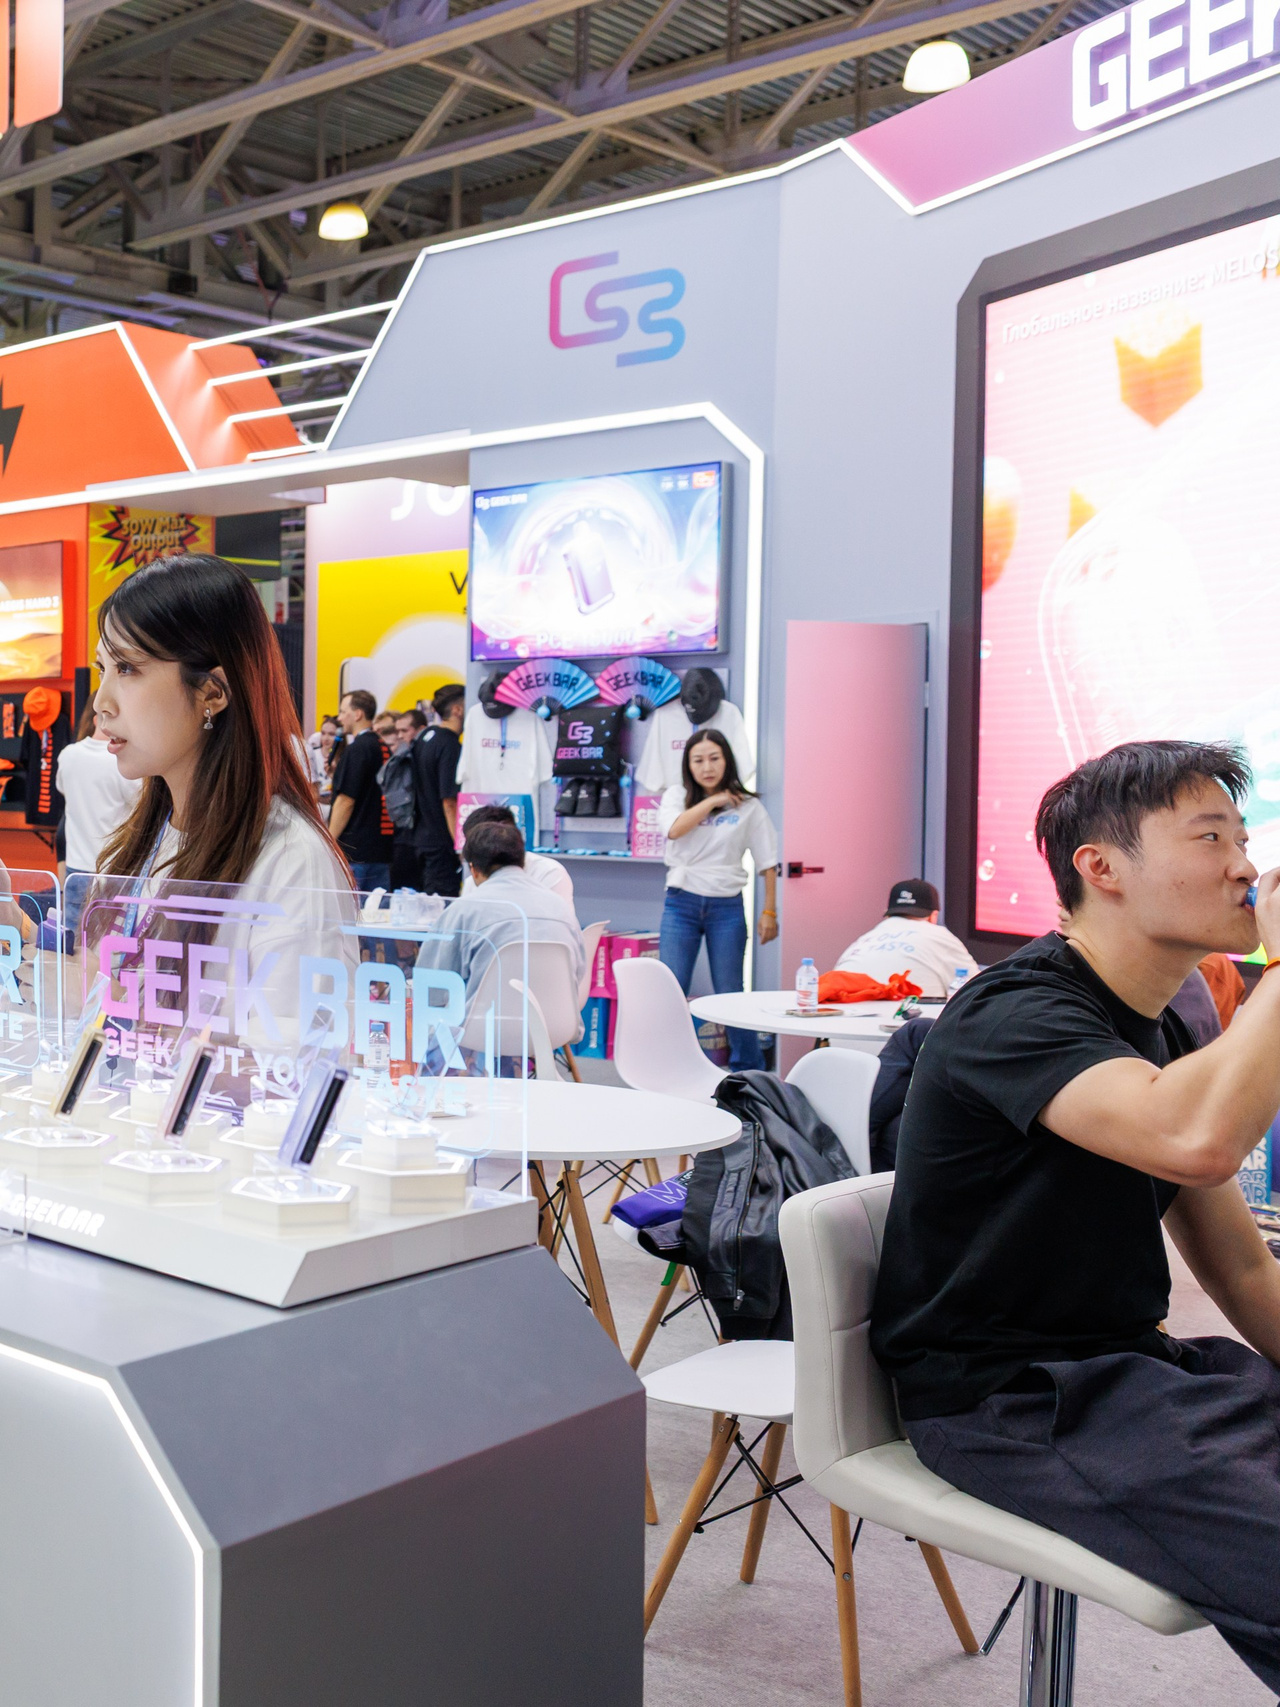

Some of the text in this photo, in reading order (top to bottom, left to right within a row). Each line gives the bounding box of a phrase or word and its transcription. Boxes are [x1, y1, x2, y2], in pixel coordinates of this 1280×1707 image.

[516, 671, 581, 692] GEEK BAR
[556, 746, 604, 760] GEEK BAR
[99, 935, 467, 1071] GEEK BAR
[103, 1027, 174, 1065] GEEK
